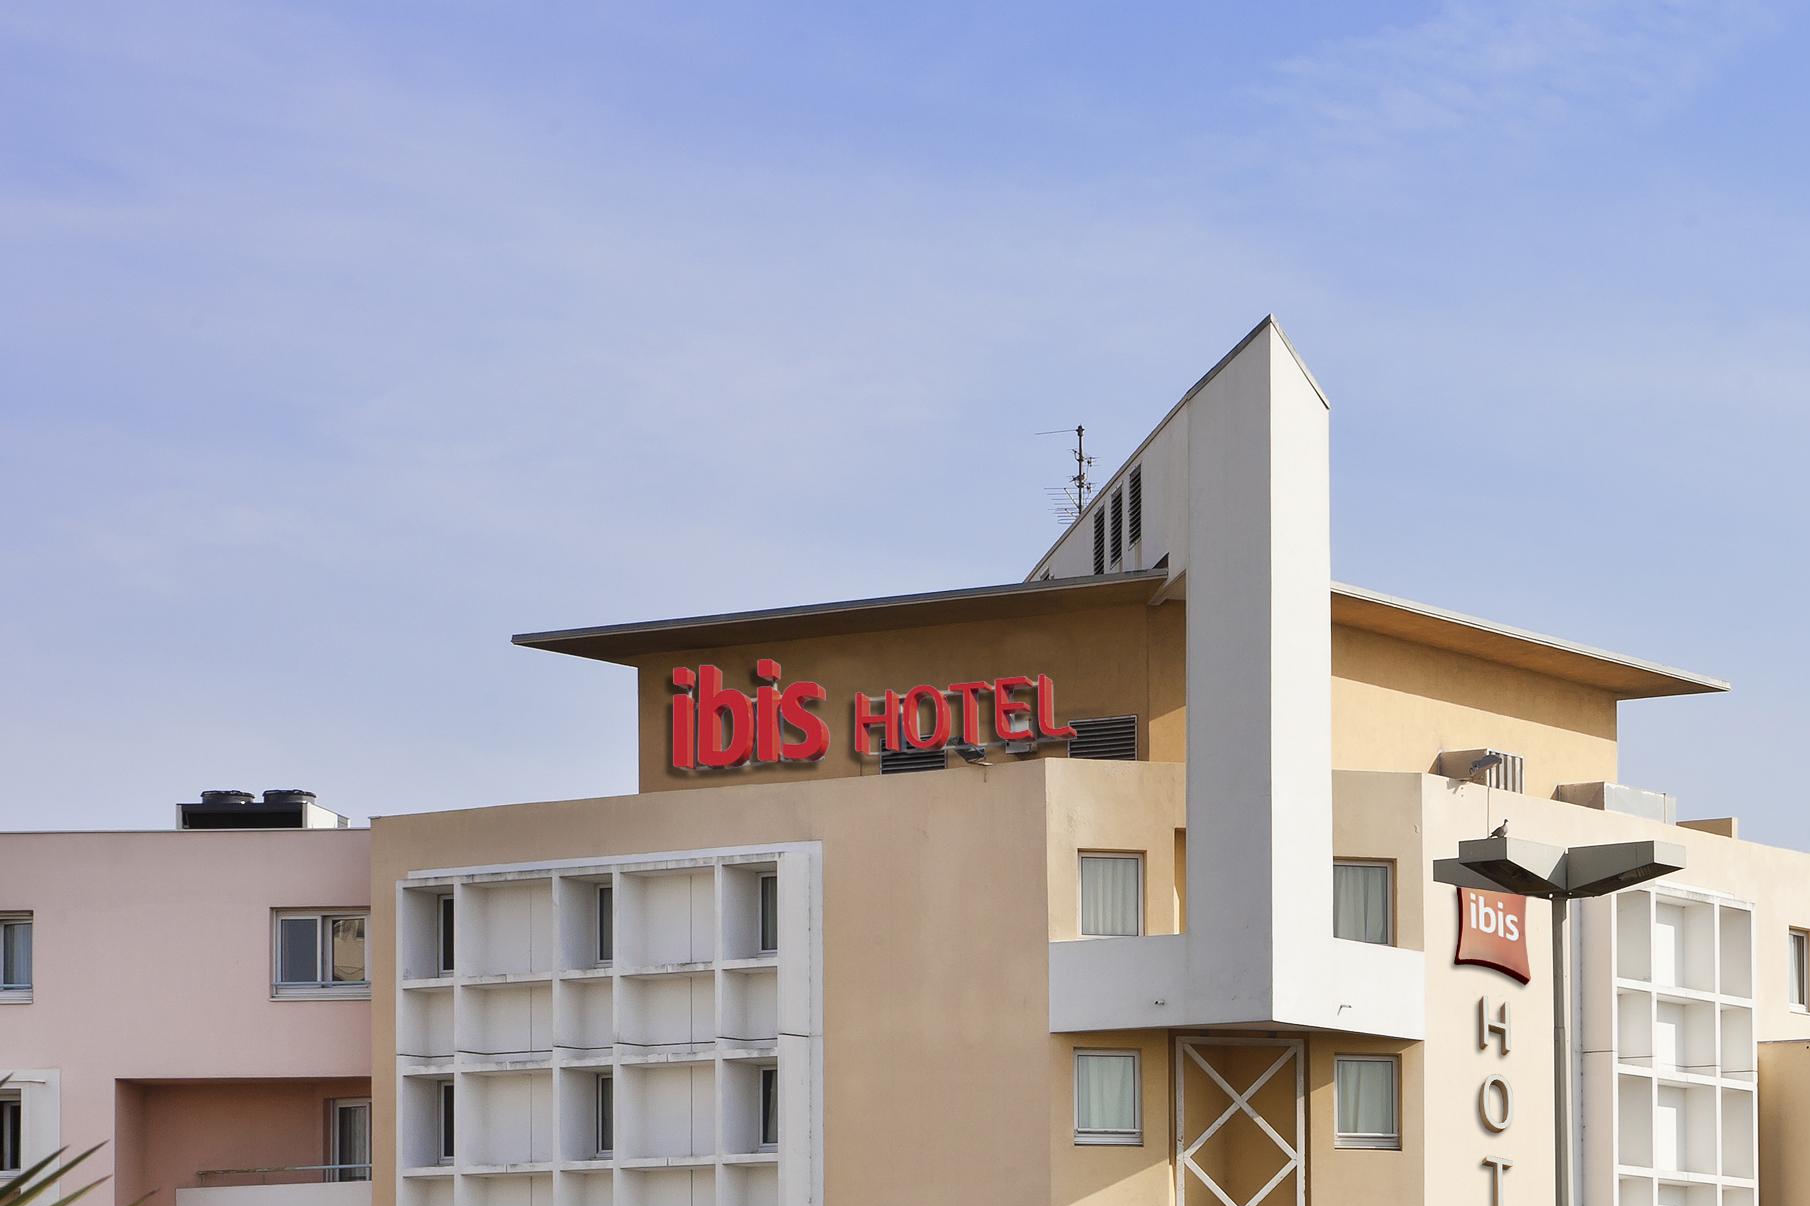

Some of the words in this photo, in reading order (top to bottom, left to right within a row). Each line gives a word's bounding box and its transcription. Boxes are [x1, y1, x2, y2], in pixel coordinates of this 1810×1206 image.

[672, 658, 830, 769] ibis
[855, 674, 1077, 755] HOTEL
[1469, 892, 1520, 943] ibis
